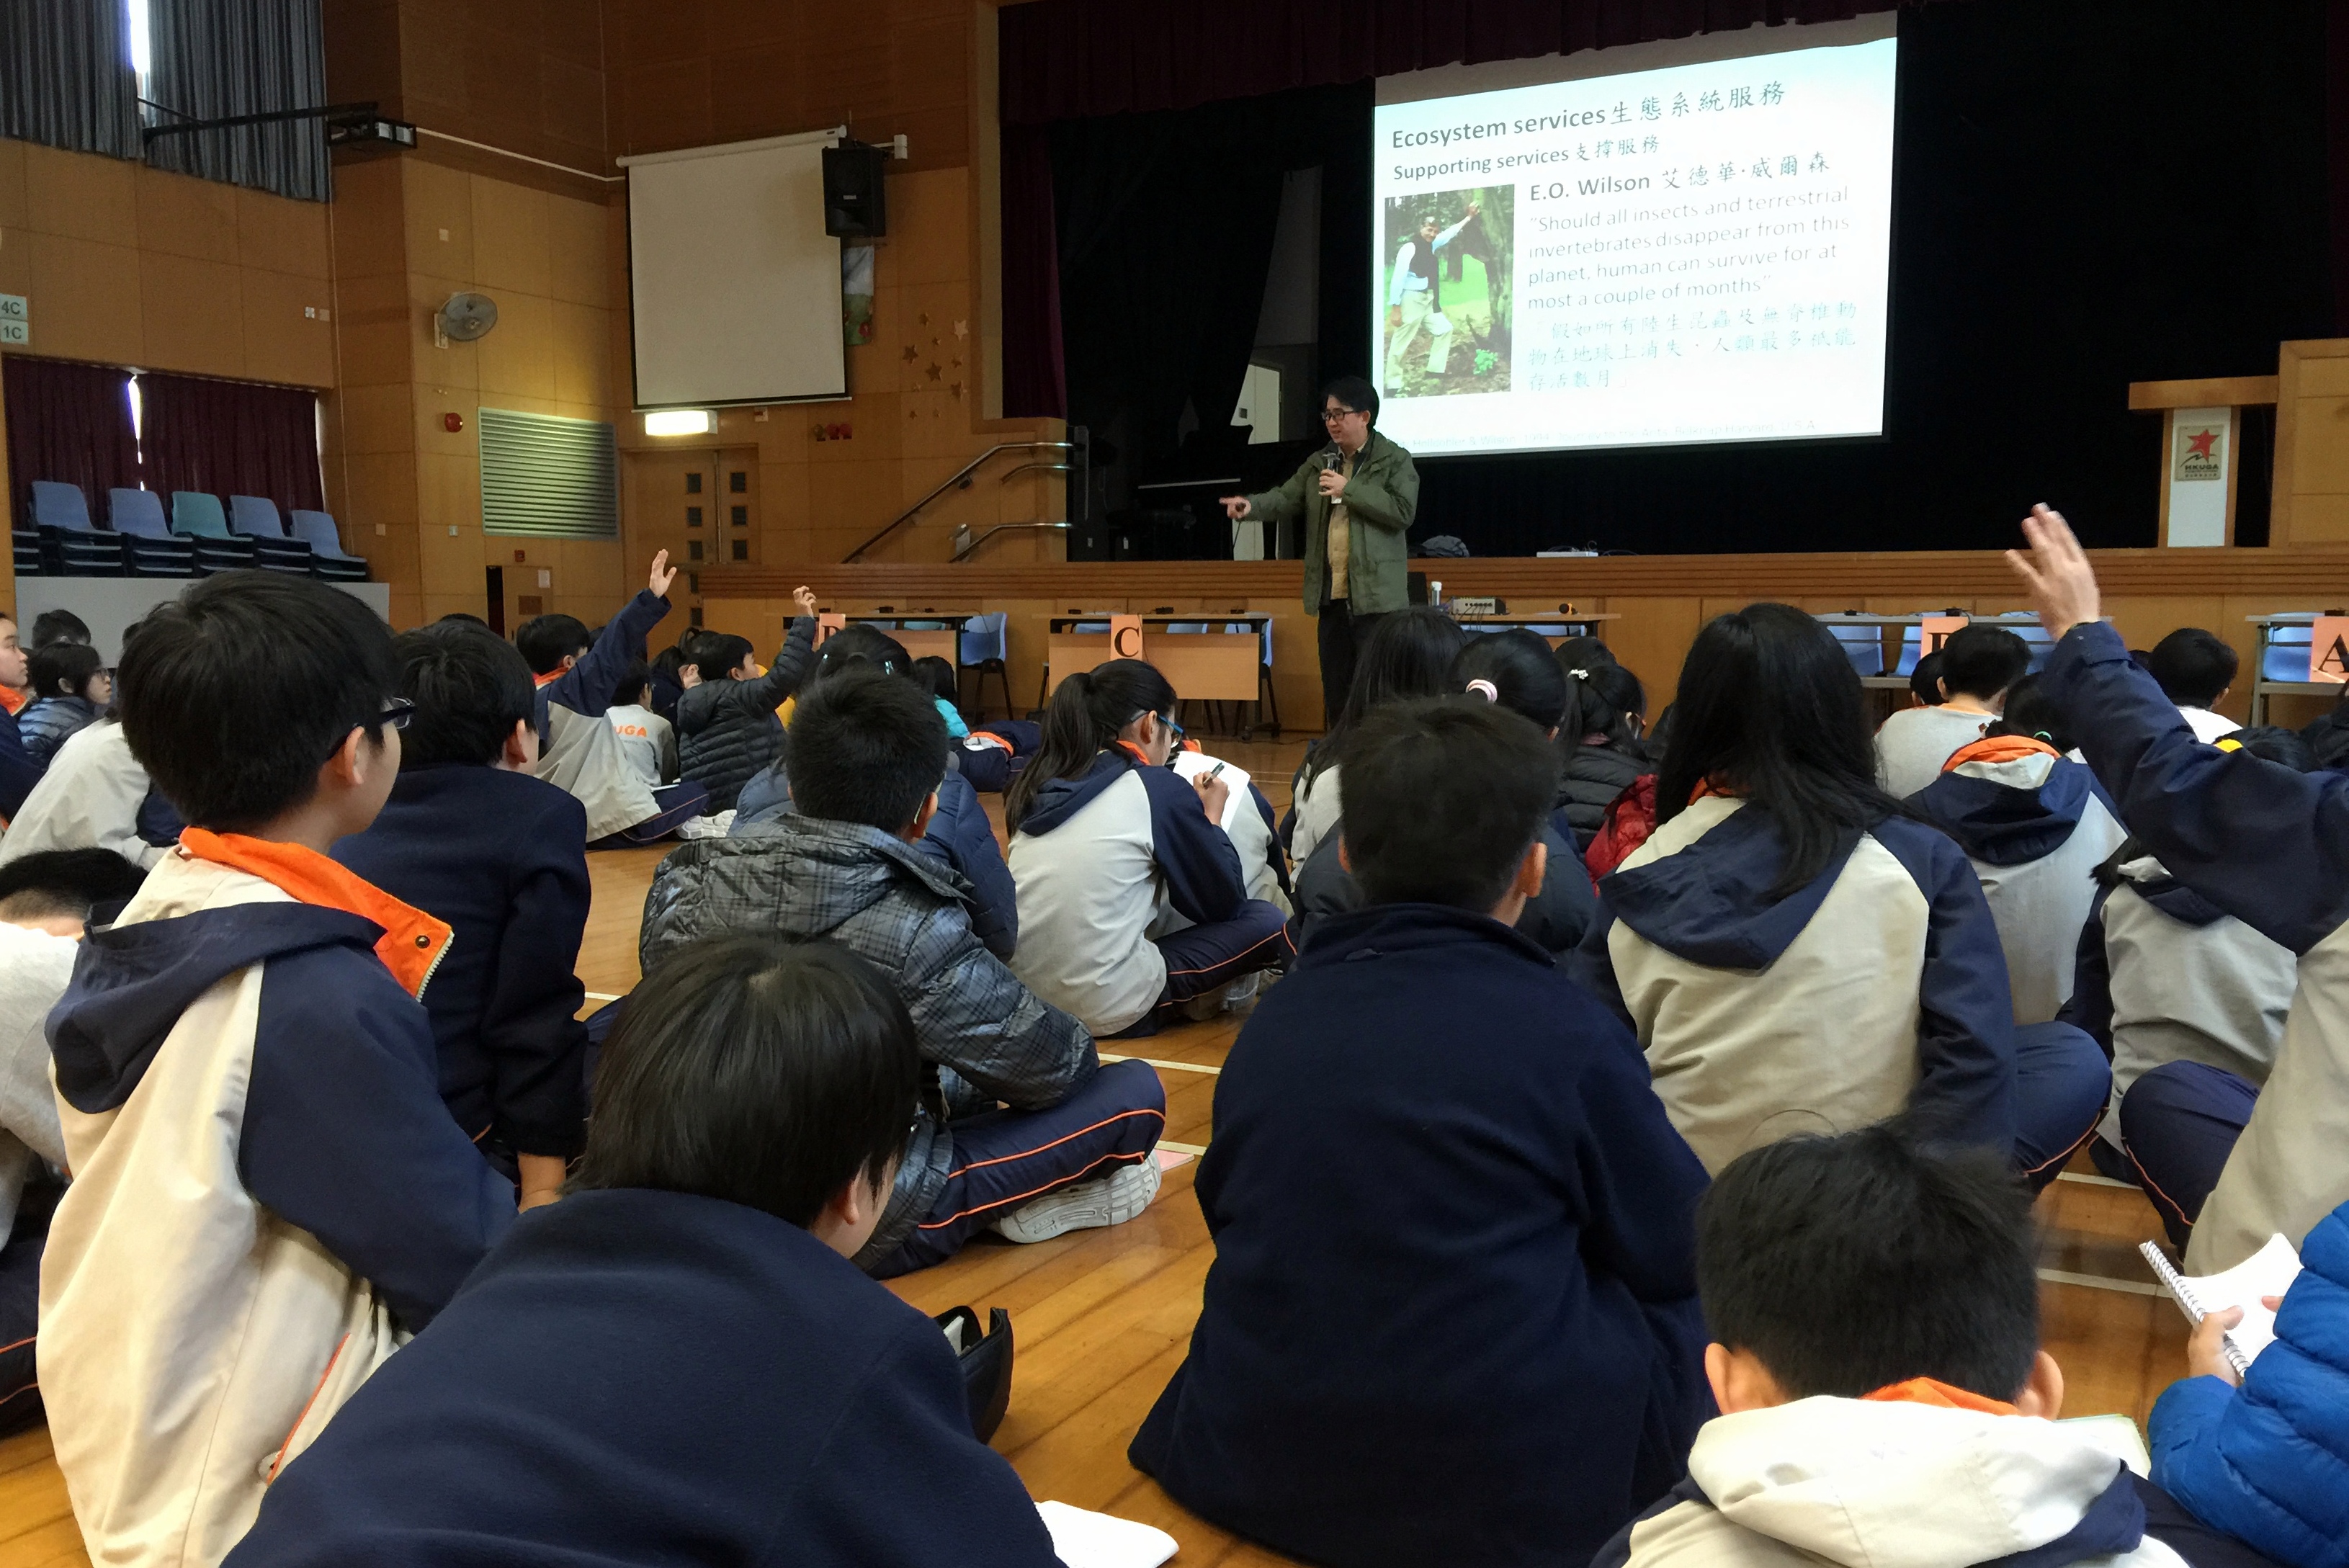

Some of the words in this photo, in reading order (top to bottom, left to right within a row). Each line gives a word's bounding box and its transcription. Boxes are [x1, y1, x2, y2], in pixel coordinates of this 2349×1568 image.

[1392, 120, 1507, 148] Ecosystem
[1514, 105, 1606, 135] services
[1610, 81, 1785, 125] 生態系統服務
[1394, 156, 1491, 180] Supporting
[1498, 148, 1569, 170] services
[1530, 182, 1570, 201] E.O.
[1578, 174, 1650, 196] Wilson
[1607, 209, 1627, 225] all
[1634, 202, 1699, 222] insects
[1704, 197, 1740, 215] and
[1748, 186, 1848, 210] terrestrial
[1529, 234, 1651, 258] invertebrates
[1657, 225, 1753, 248] disappear
[1758, 220, 1805, 238] from
[1812, 215, 1850, 232] this
[1529, 266, 1591, 287] planet,
[1598, 261, 1662, 279] human
[1668, 256, 1701, 272] can
[1707, 249, 1778, 269] survive
[1784, 245, 1812, 262] for
[1818, 243, 1838, 259] at
[1, 300, 21, 315] 4C
[1528, 292, 1572, 310] most
[1578, 294, 1588, 306] a
[1594, 282, 1656, 305] couple
[1662, 281, 1683, 300] of
[3, 325, 22, 340] 1C
[1114, 627, 1140, 658] C
[2318, 633, 2349, 673] A
